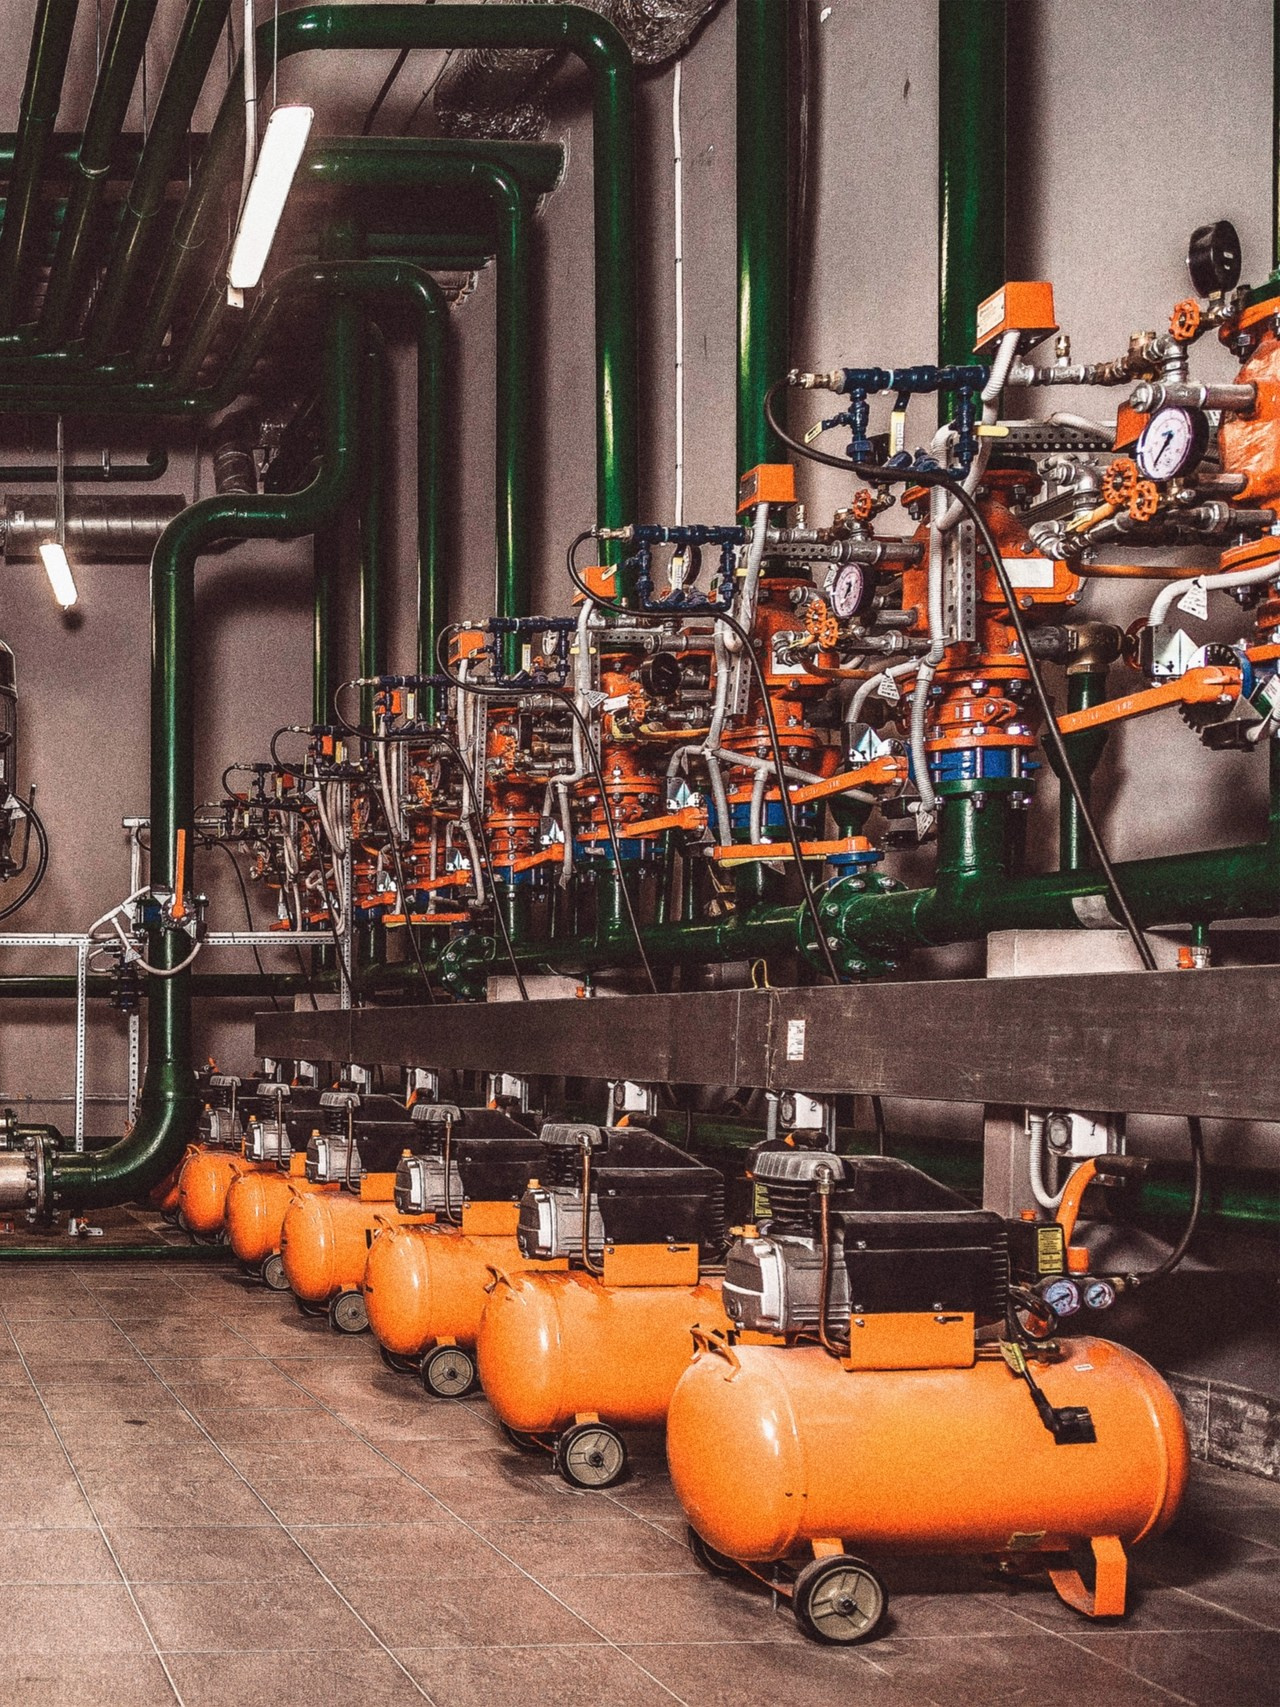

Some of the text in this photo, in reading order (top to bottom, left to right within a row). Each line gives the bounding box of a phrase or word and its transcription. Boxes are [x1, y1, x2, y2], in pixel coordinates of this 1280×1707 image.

[511, 1078, 517, 1087] 4
[810, 1101, 818, 1112] 2
[1090, 1121, 1097, 1136] 1
